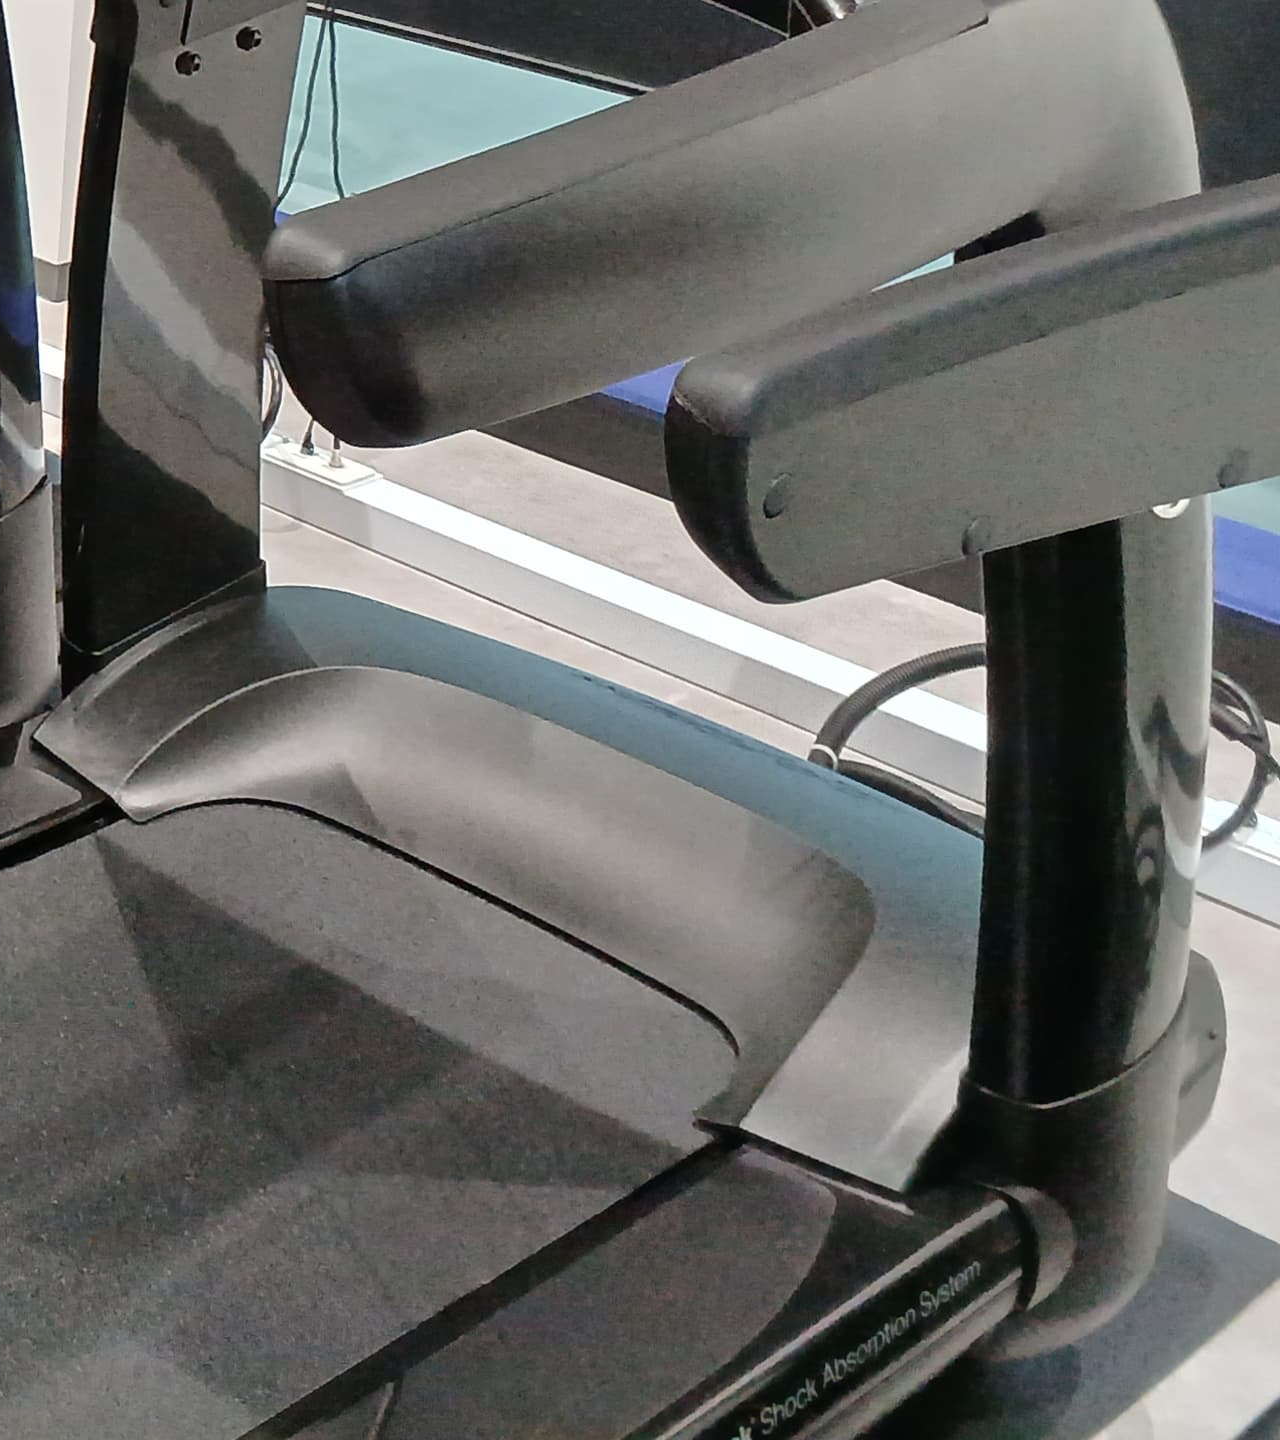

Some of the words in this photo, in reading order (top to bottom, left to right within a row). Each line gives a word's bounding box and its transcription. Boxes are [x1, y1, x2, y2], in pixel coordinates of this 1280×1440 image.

[760, 1378, 818, 1435] Shock
[823, 1308, 916, 1388] Absorption
[919, 1261, 981, 1318] System
